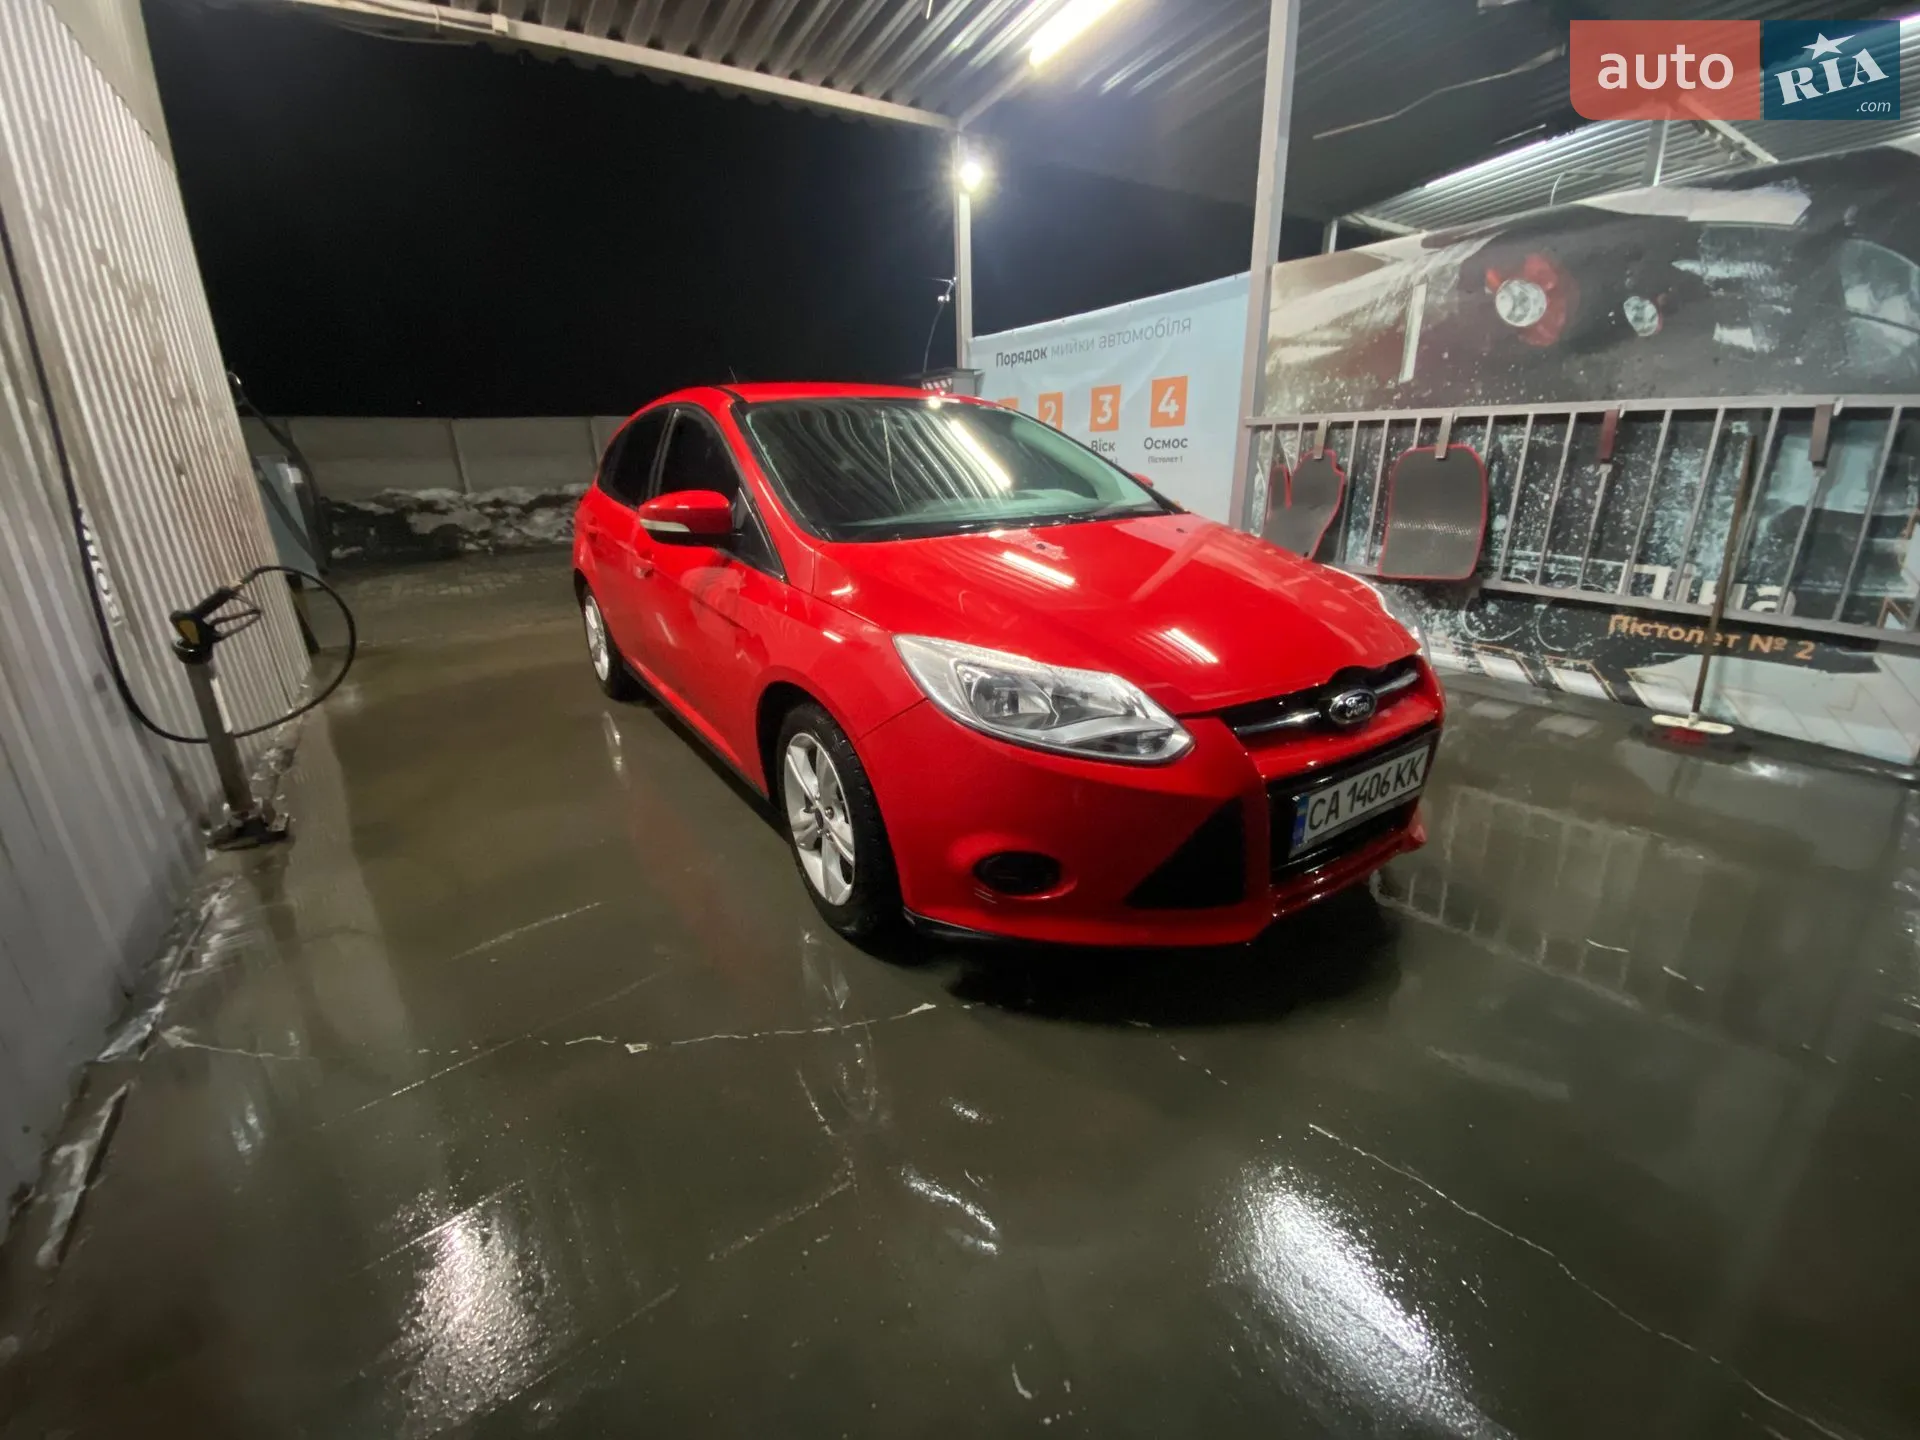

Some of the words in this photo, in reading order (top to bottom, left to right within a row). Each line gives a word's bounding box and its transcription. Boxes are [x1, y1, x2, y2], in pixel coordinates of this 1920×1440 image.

[995, 346, 1048, 368] Порядок
[1050, 336, 1096, 359] мийки
[1098, 316, 1192, 350] автомобіля
[1044, 401, 1057, 427] 2
[1096, 394, 1114, 425] 3
[1157, 385, 1180, 420] 4
[1090, 438, 1116, 452] Віск
[1143, 437, 1189, 450] Осмос
[1608, 613, 1741, 650] Пістолет
[1794, 640, 1817, 661] 2
[1308, 790, 1341, 831] CA
[1346, 766, 1392, 814] 1406
[1392, 752, 1426, 792] KK
